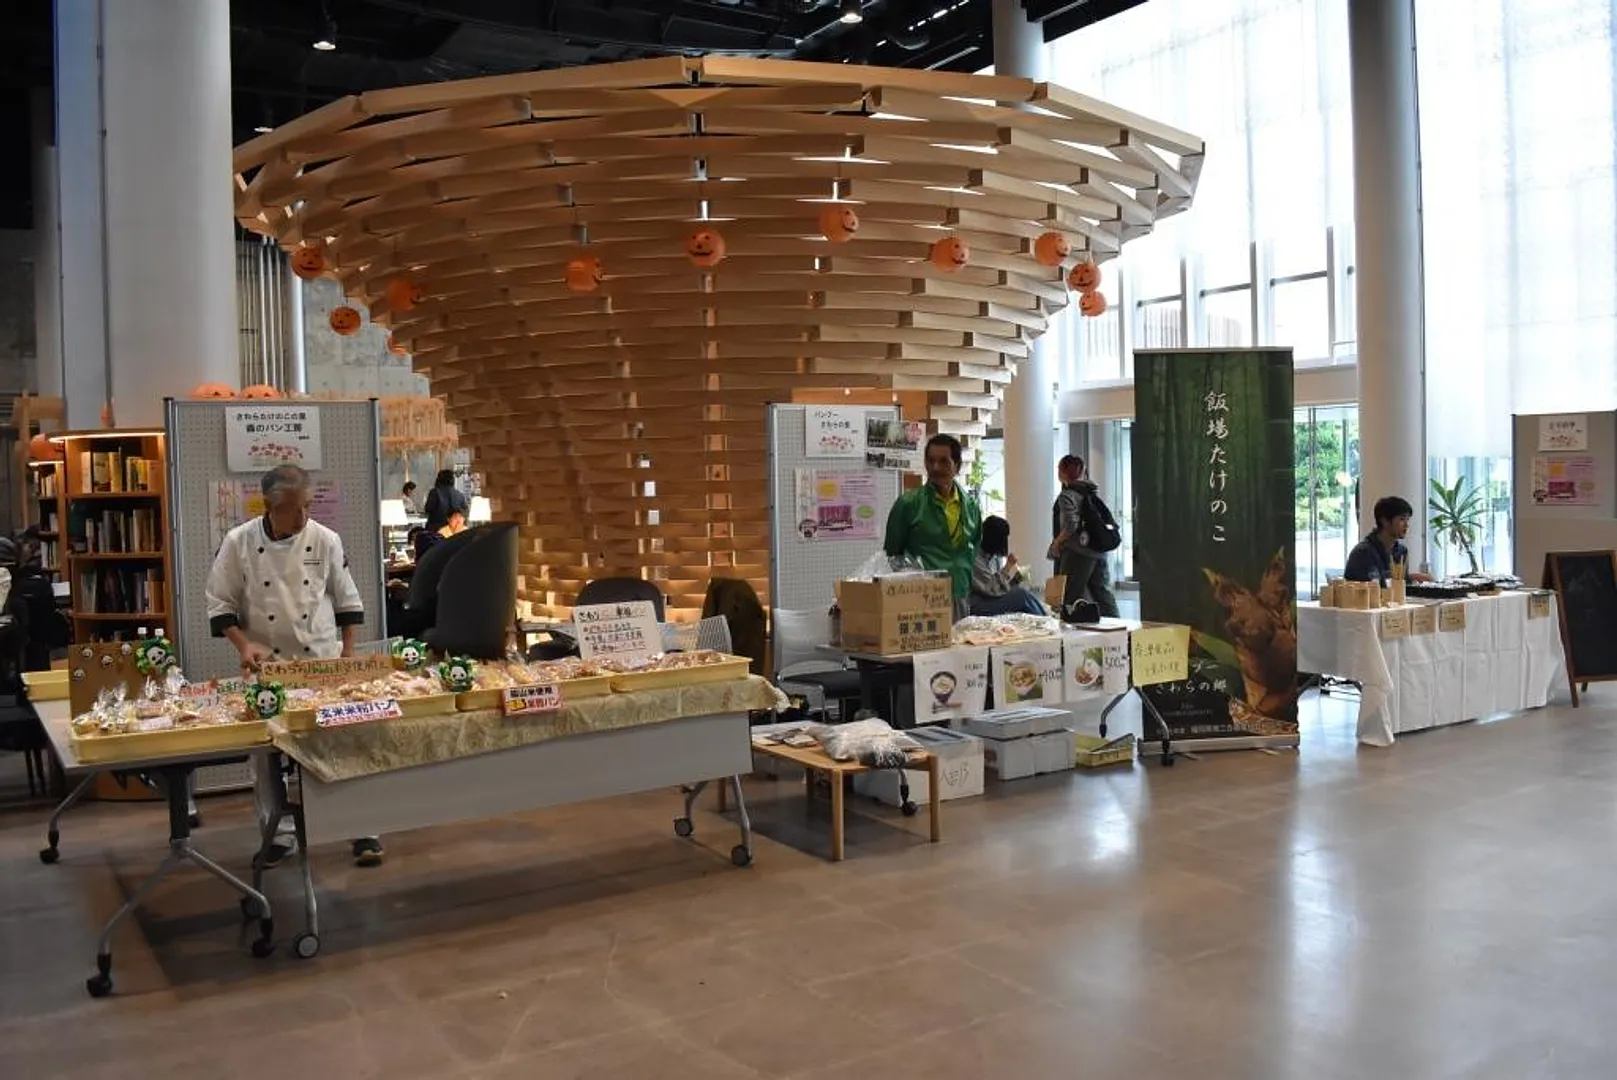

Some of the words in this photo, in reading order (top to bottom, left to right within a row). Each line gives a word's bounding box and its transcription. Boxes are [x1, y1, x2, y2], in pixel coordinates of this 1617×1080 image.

[1204, 389, 1229, 542] 飯場たけのこ
[320, 698, 396, 718] 玄米米粉パン
